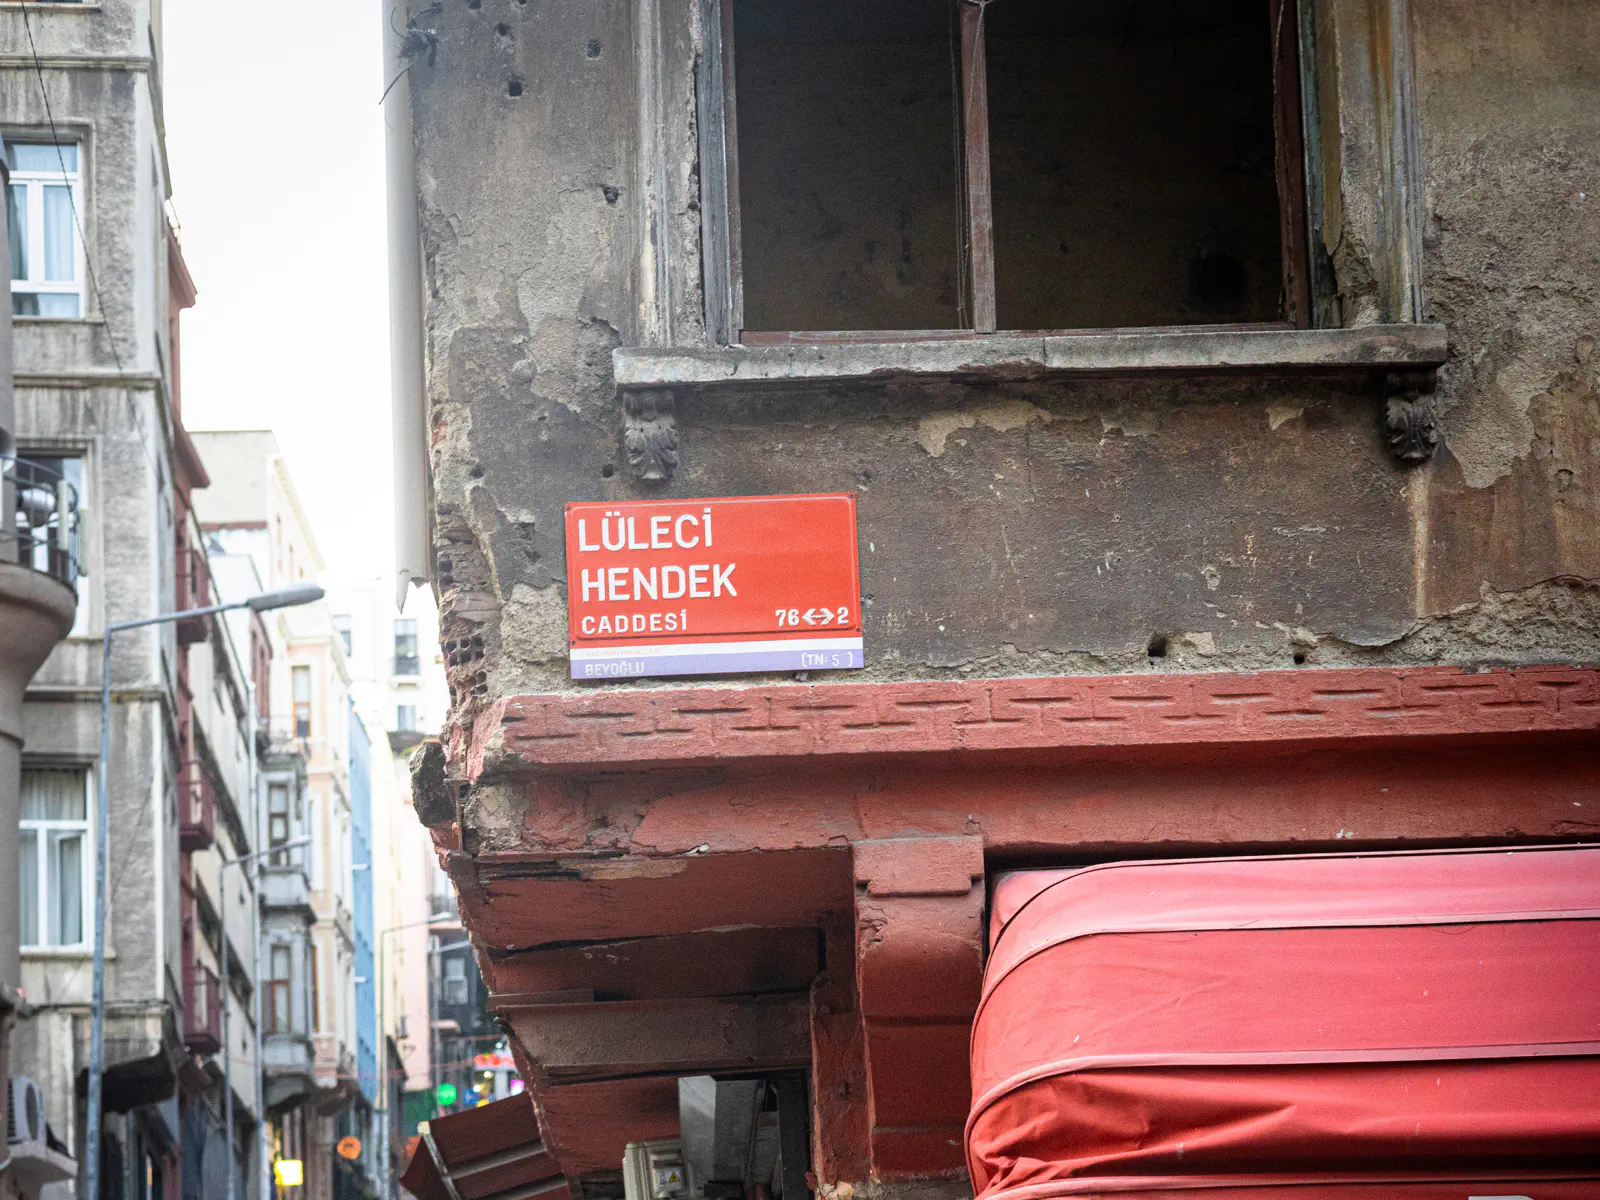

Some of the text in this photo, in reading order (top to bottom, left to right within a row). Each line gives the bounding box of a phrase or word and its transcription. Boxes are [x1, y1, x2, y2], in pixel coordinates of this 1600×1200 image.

[579, 508, 712, 551] LÜLECİ
[582, 564, 737, 601] HENDEK
[582, 610, 687, 634] CADDESİ
[775, 606, 850, 627] 76 2
[585, 661, 644, 676] BEYOĞLU
